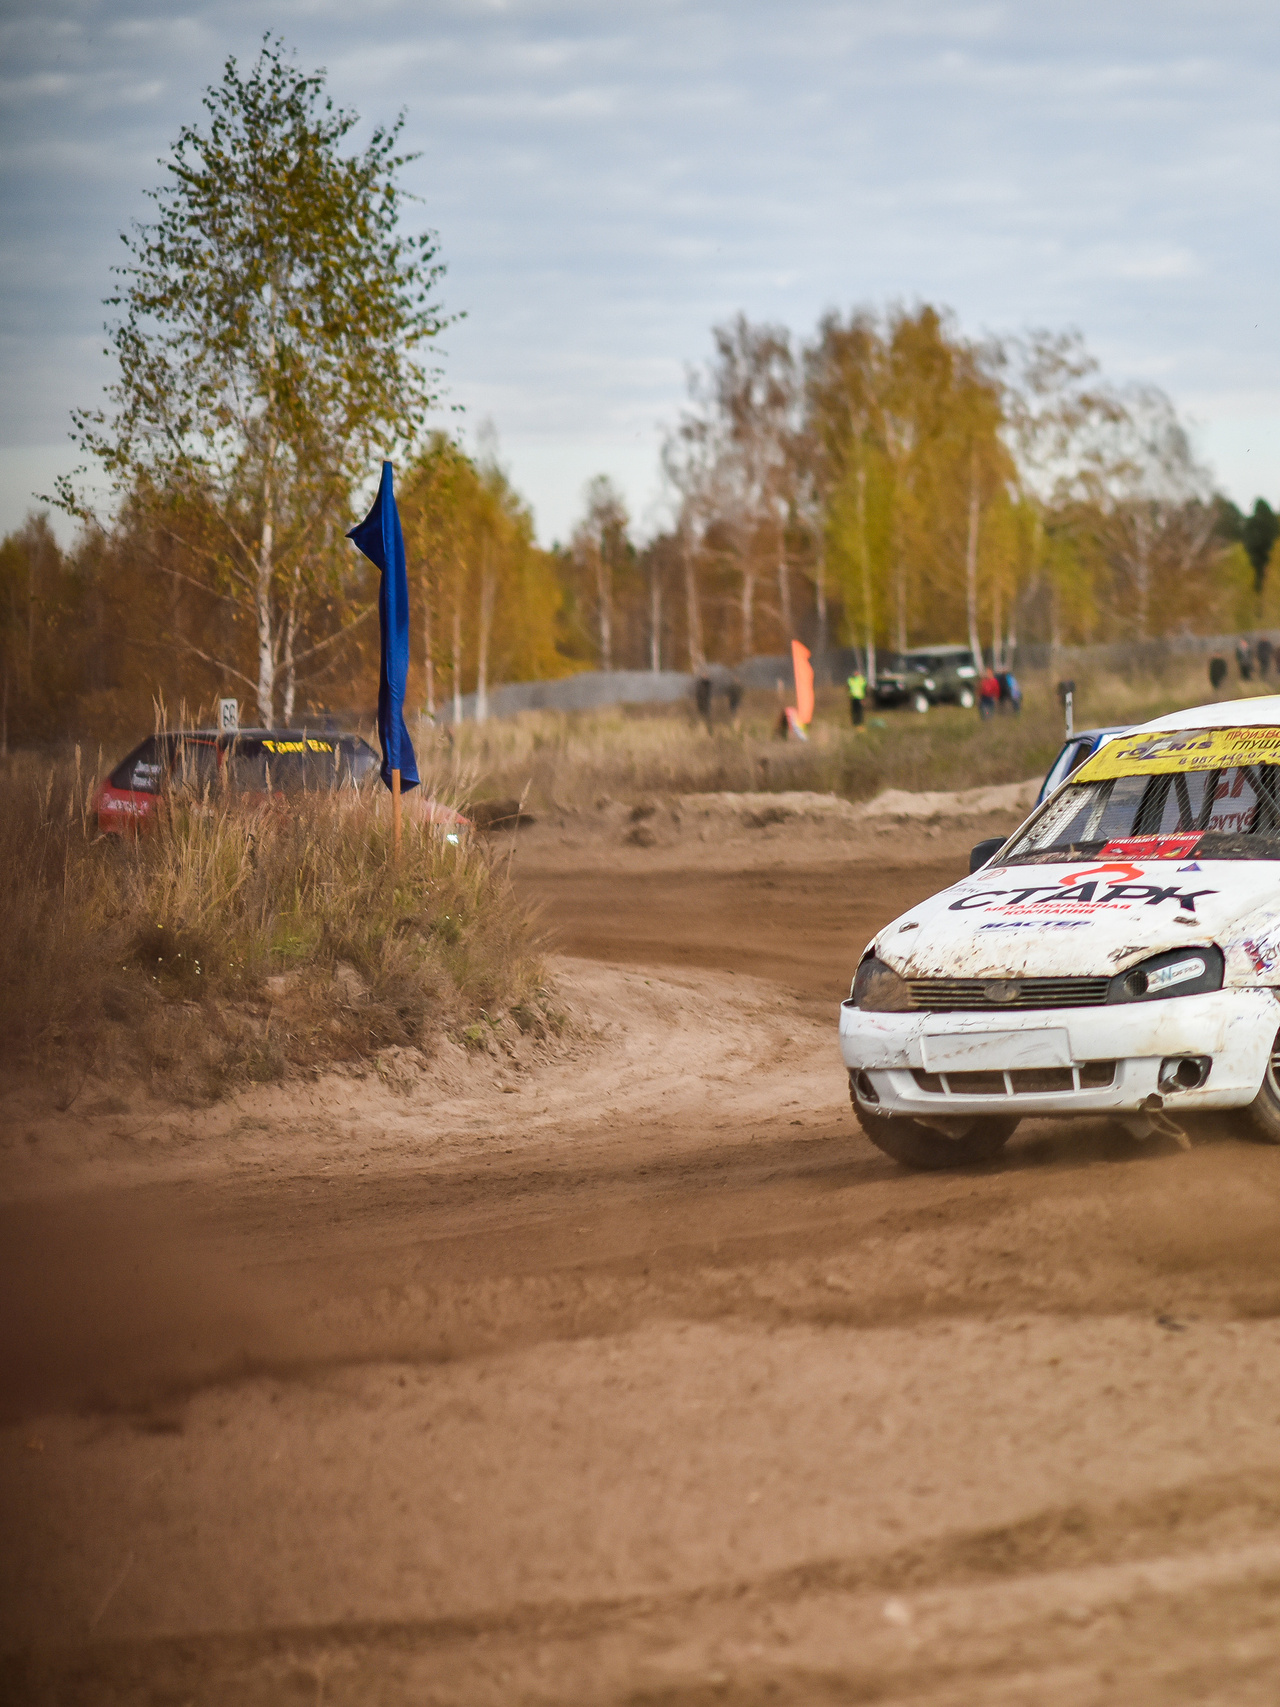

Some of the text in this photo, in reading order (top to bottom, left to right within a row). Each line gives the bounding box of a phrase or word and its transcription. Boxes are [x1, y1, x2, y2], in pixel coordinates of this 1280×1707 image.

[1191, 755, 1216, 765] 987
[948, 881, 1221, 912] СТАРК
[984, 902, 1132, 913] МЕТАЛЛОЛОМНАЯ
[1002, 908, 1097, 916] КОМПАНИЯ
[979, 920, 1092, 930] МАСТЕР
